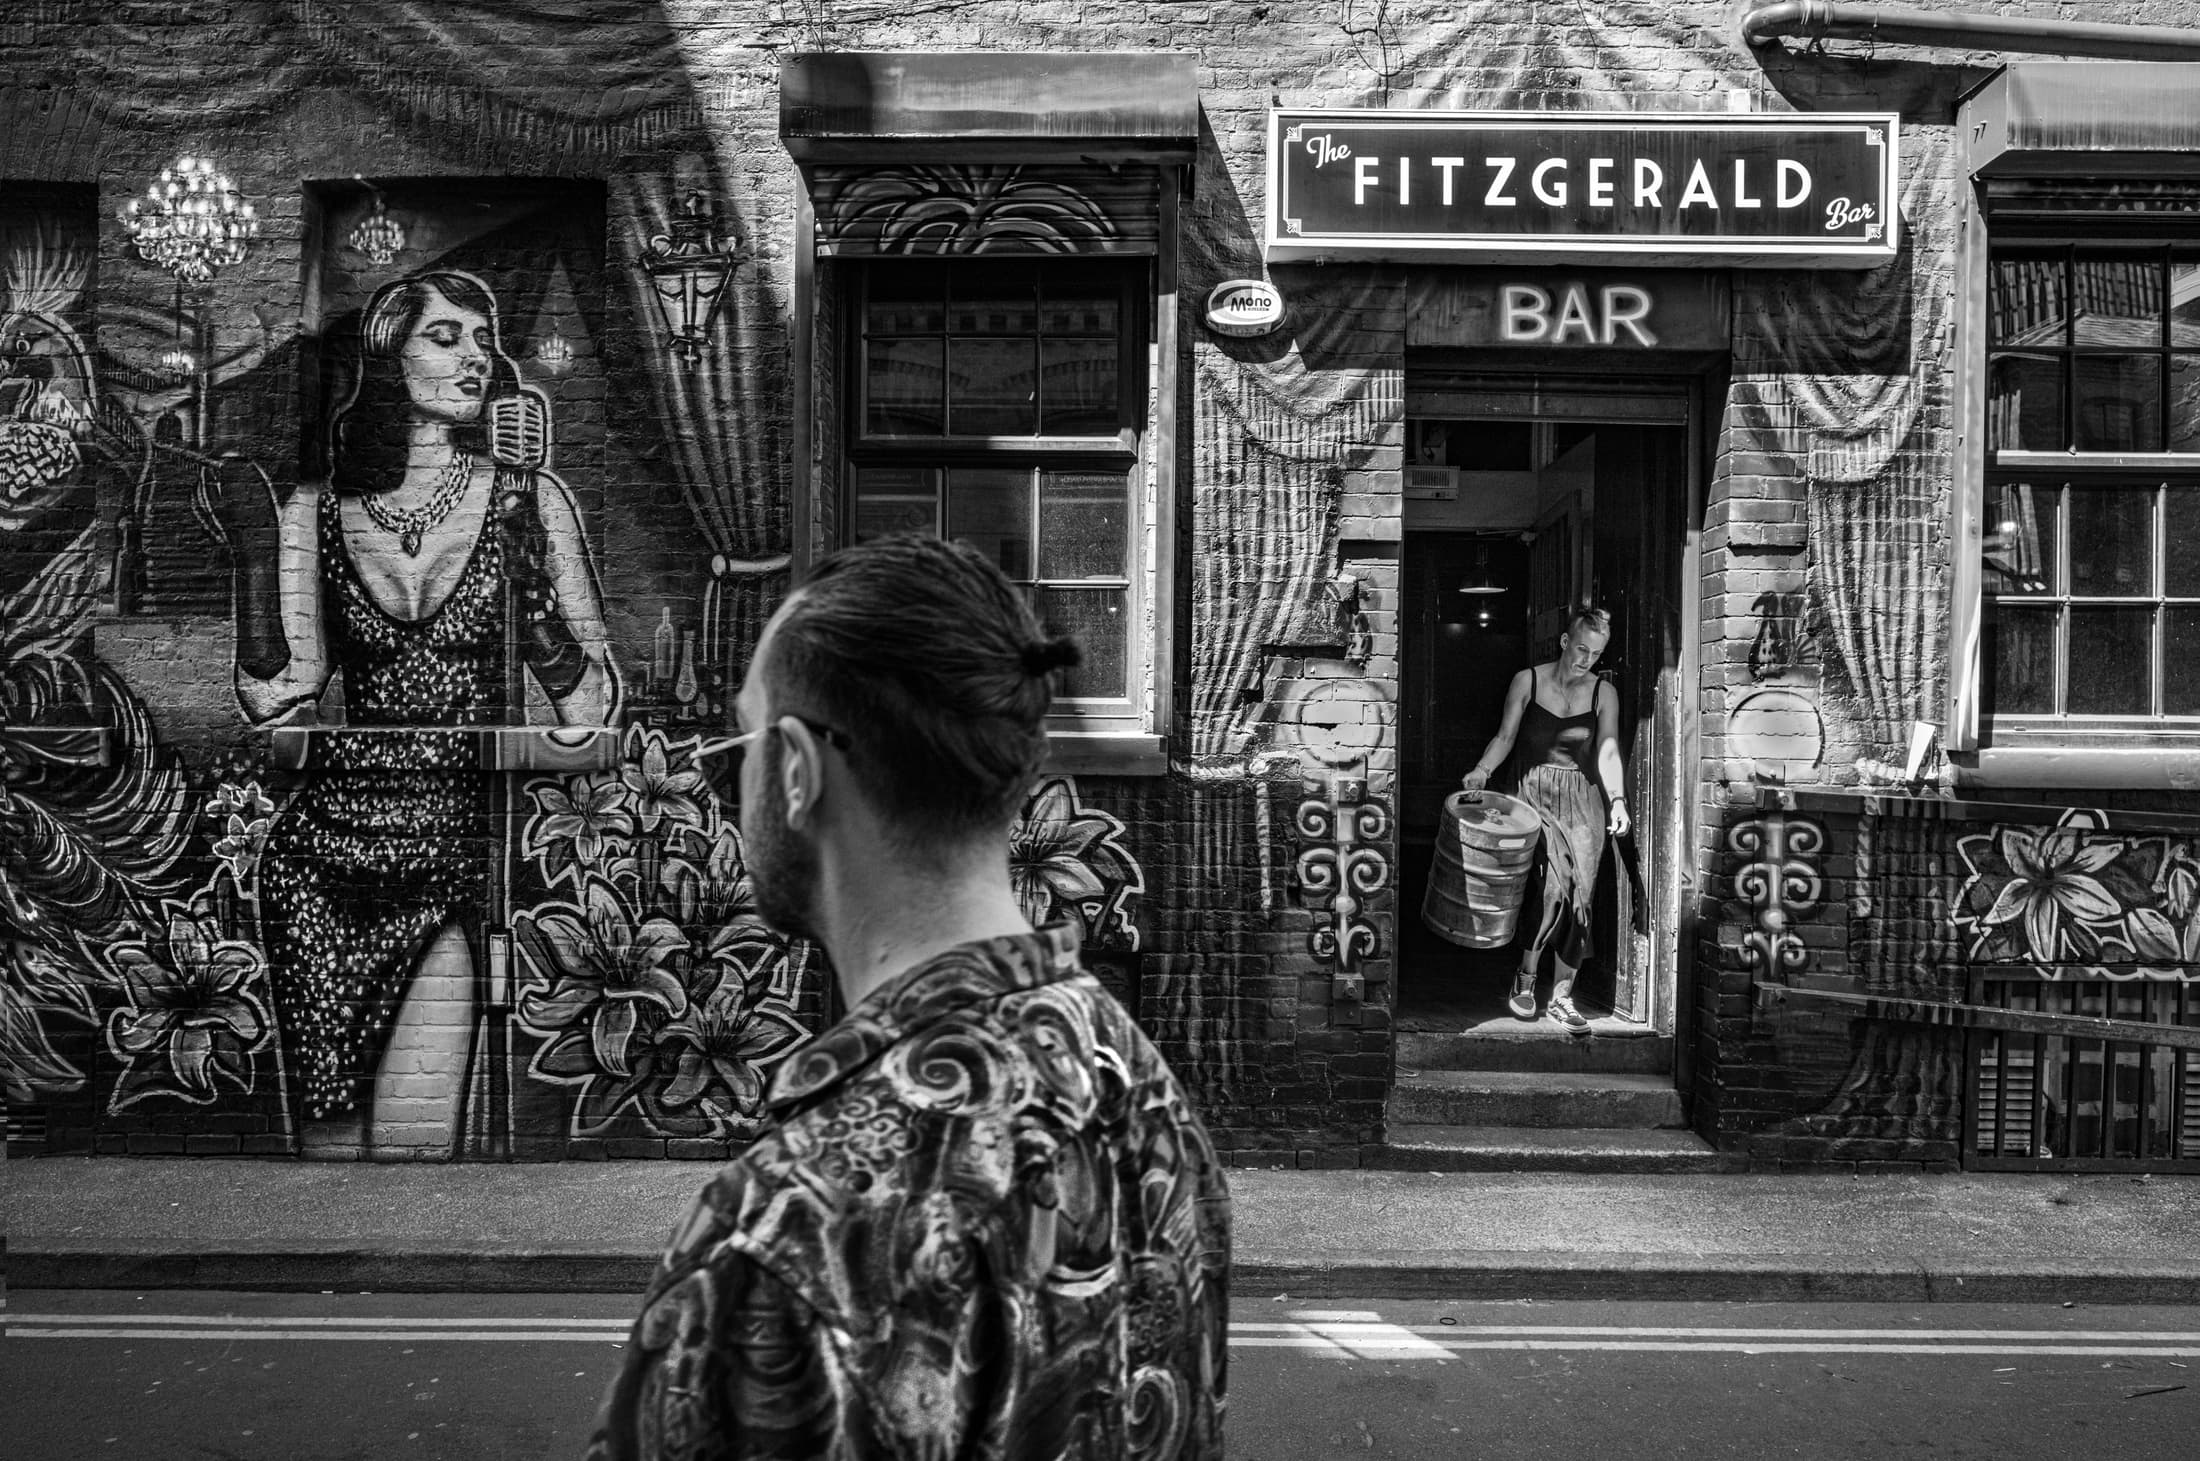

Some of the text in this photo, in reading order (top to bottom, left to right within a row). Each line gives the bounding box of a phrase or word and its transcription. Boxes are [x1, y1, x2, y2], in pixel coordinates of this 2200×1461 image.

[1306, 134, 1875, 230] The FITZGERALD Bar
[1503, 284, 1656, 347] BAR
